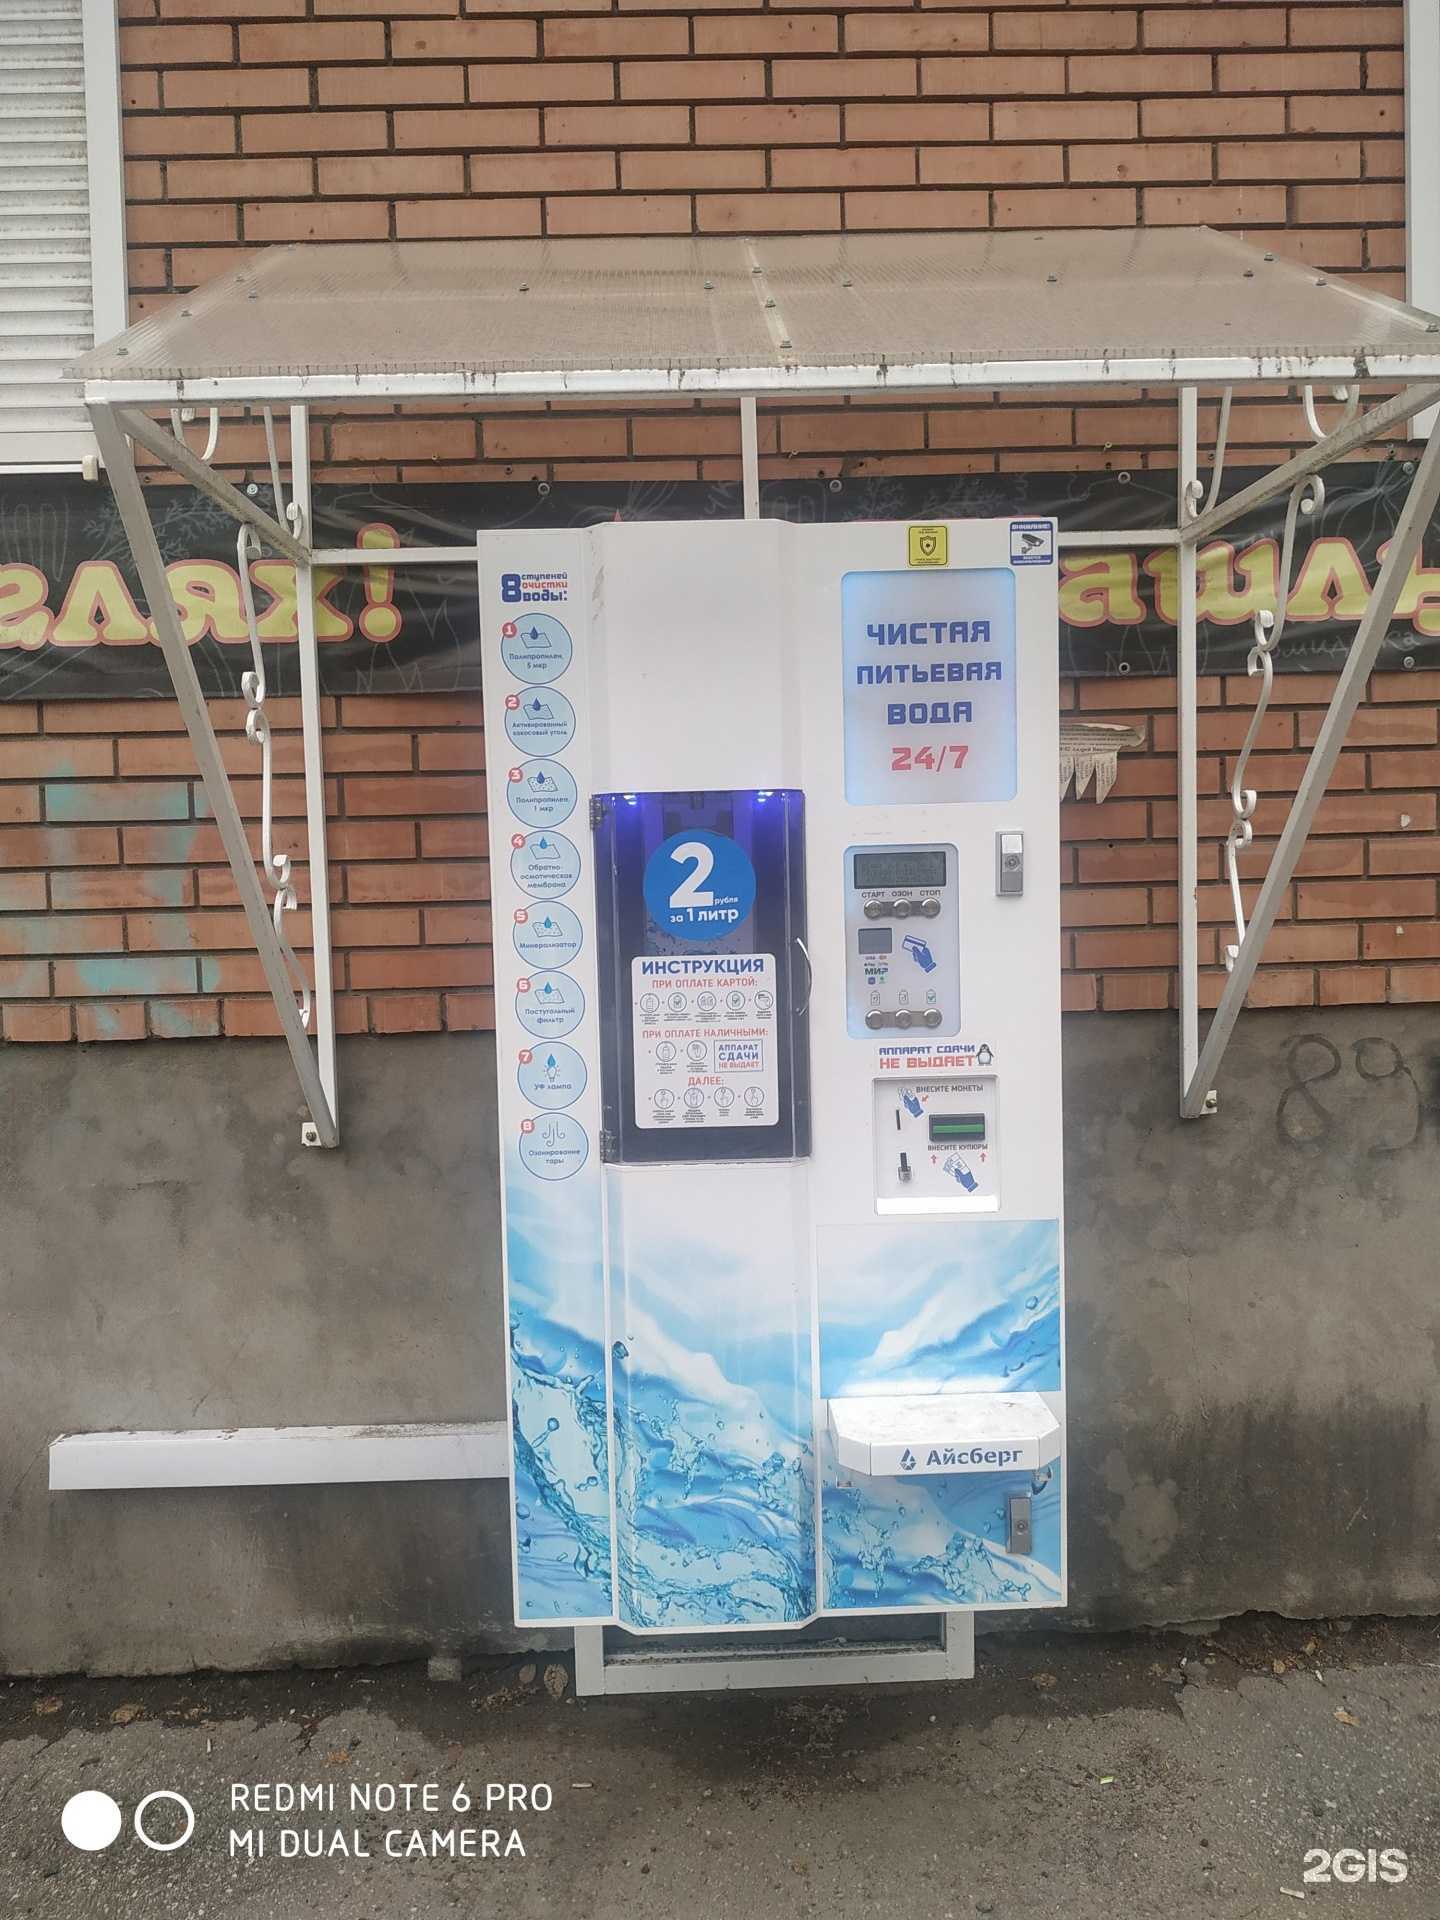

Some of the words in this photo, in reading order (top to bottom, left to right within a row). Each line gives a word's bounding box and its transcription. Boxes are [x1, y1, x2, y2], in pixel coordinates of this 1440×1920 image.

[521, 572, 568, 581] ступеней
[501, 573, 521, 602] 8
[522, 581, 568, 589] очистки
[523, 589, 568, 601] воды:
[866, 620, 991, 646] ЧИСТАЯ
[856, 661, 1002, 685] ПИТЬЕВАЯ
[887, 701, 973, 726] ВОДА
[891, 745, 969, 773] 24/7
[669, 841, 715, 909] 2
[861, 891, 885, 899] СТАРТ
[891, 890, 913, 898] ОЗОН
[919, 889, 941, 897] СТОП
[714, 896, 739, 905] рубля
[669, 914, 684, 923] за
[686, 908, 695, 922] 1
[698, 908, 739, 924] литр
[641, 958, 764, 976] ИНСТРУКЦИЯ
[652, 980, 672, 989] ПРИ
[675, 978, 713, 988] ОПЛАТЕ
[717, 976, 758, 987] КАРТОЙ:
[642, 1030, 661, 1039] ПРИ
[664, 1029, 700, 1038] ОПЛАТЕ
[703, 1027, 768, 1037] НАЛИЧНЫМИ:
[718, 1043, 758, 1051] АППАРАТ
[879, 1046, 932, 1056] АППАРАТ
[936, 1044, 976, 1054] СДАЧИ
[718, 1052, 759, 1061] СДАЧИ
[879, 1058, 901, 1069] НЕ
[906, 1055, 975, 1068] ВЫДАЕТ
[916, 1086, 949, 1094] ВНЕСИТЕ
[951, 1084, 984, 1093] МОНЕТЫ
[959, 1143, 988, 1151] КУПЮРЫ
[926, 1447, 1024, 1467] Айсберг
